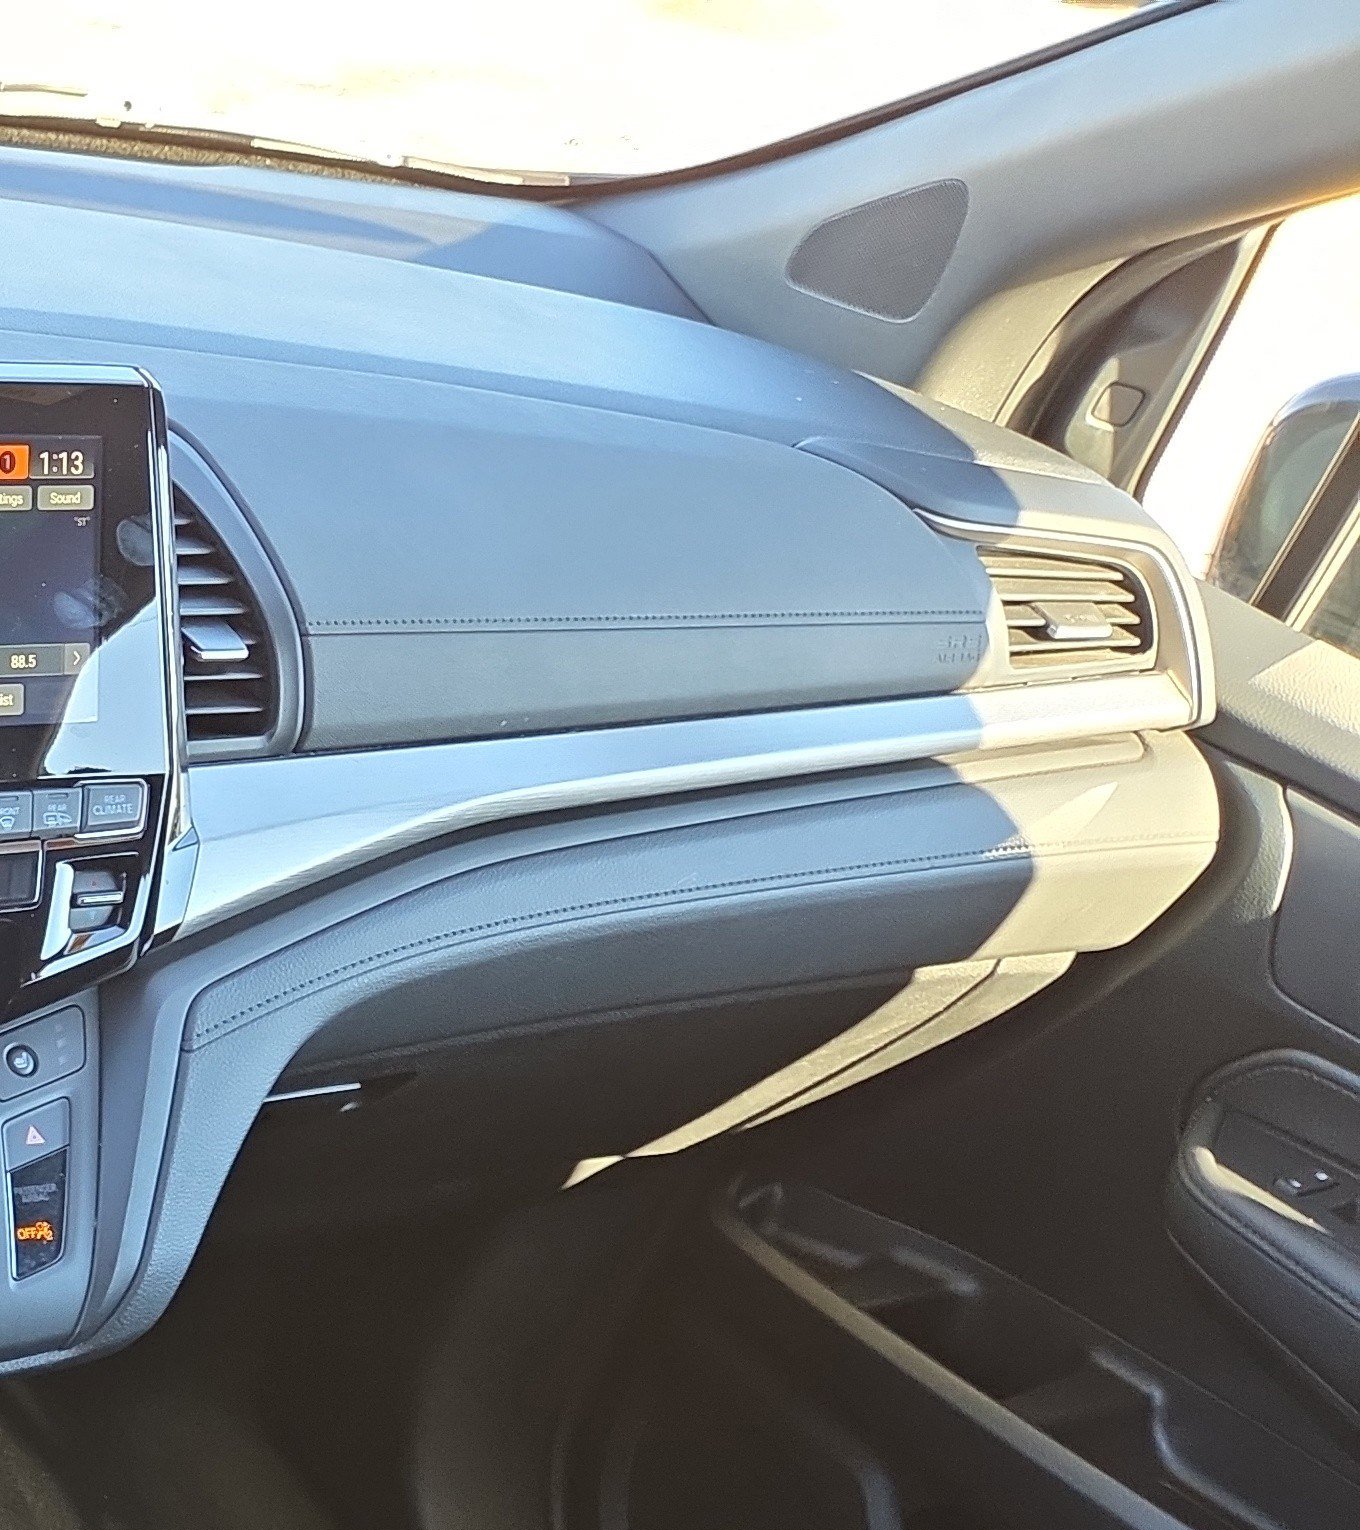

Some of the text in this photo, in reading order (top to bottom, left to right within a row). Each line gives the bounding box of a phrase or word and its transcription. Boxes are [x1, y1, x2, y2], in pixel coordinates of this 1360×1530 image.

[4, 455, 11, 469] 1
[39, 451, 84, 475] 1:13
[50, 492, 81, 504] Sound
[10, 654, 37, 669] 88.5
[104, 794, 126, 804] REAR
[92, 805, 134, 817] CLIMATE
